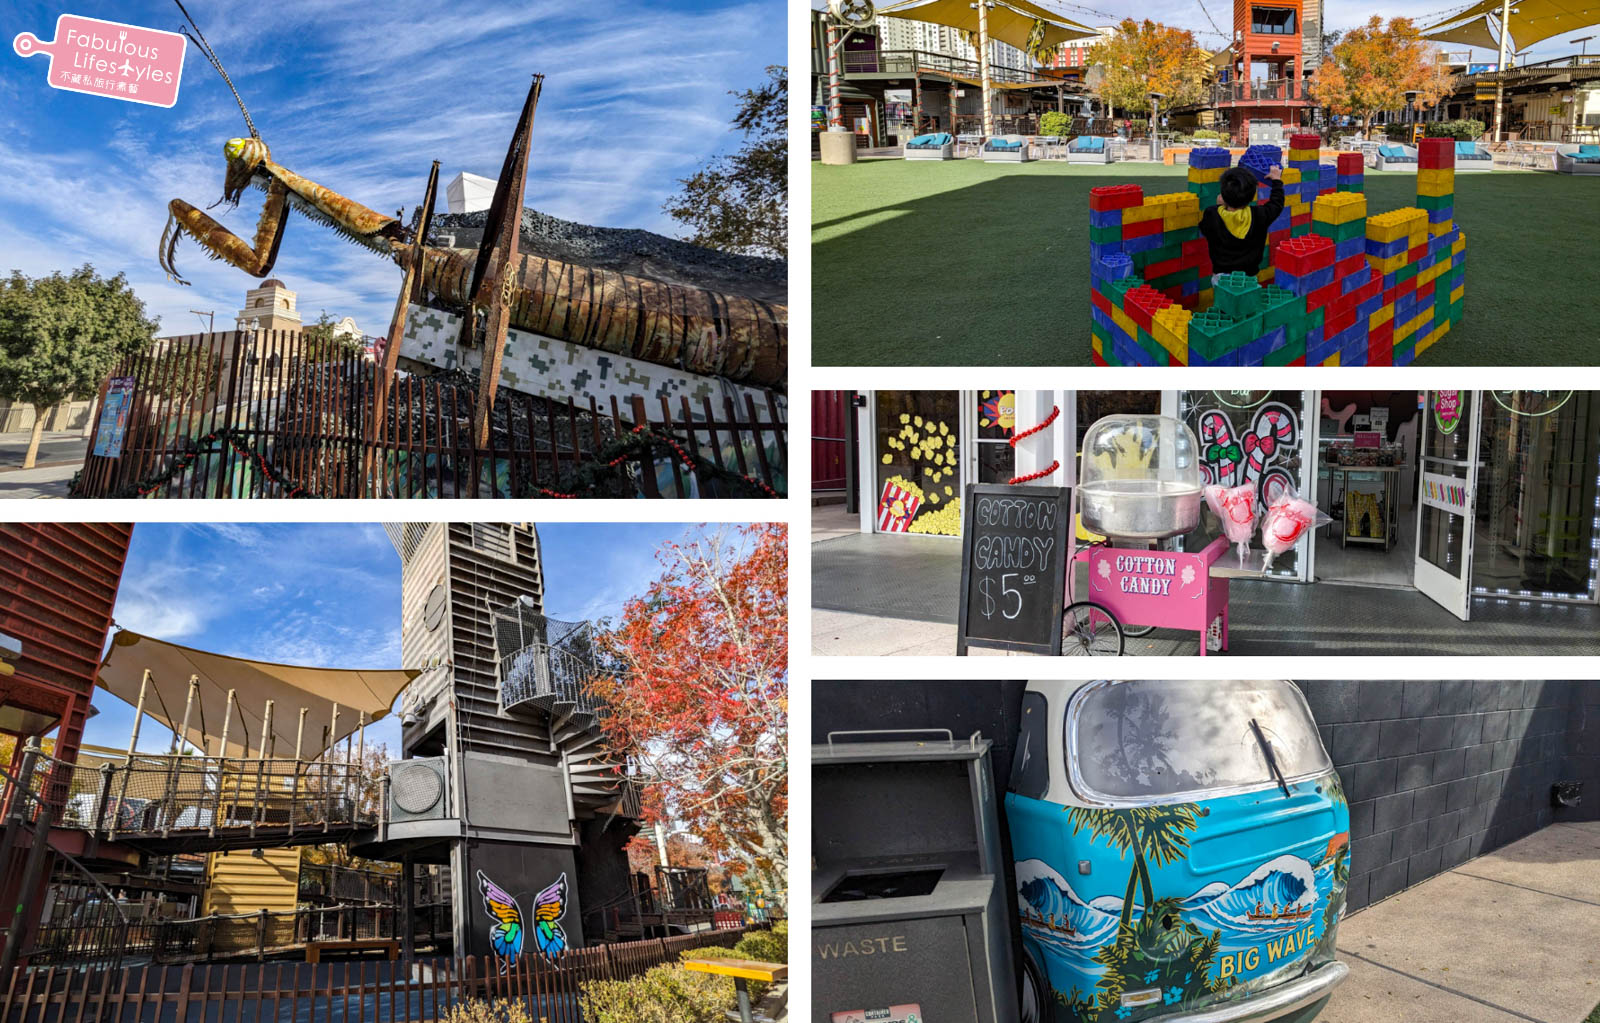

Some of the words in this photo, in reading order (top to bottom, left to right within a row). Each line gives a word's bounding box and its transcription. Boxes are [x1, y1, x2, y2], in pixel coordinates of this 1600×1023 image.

[1440, 398, 1457, 410] Shop
[976, 498, 1057, 531] COTTON
[974, 536, 1054, 571] CANDY
[1116, 555, 1176, 576] COTTON
[1120, 576, 1172, 596] CANDY
[818, 935, 908, 960] WASTE
[1220, 947, 1260, 979] BIG
[1266, 924, 1316, 963] WAVE
